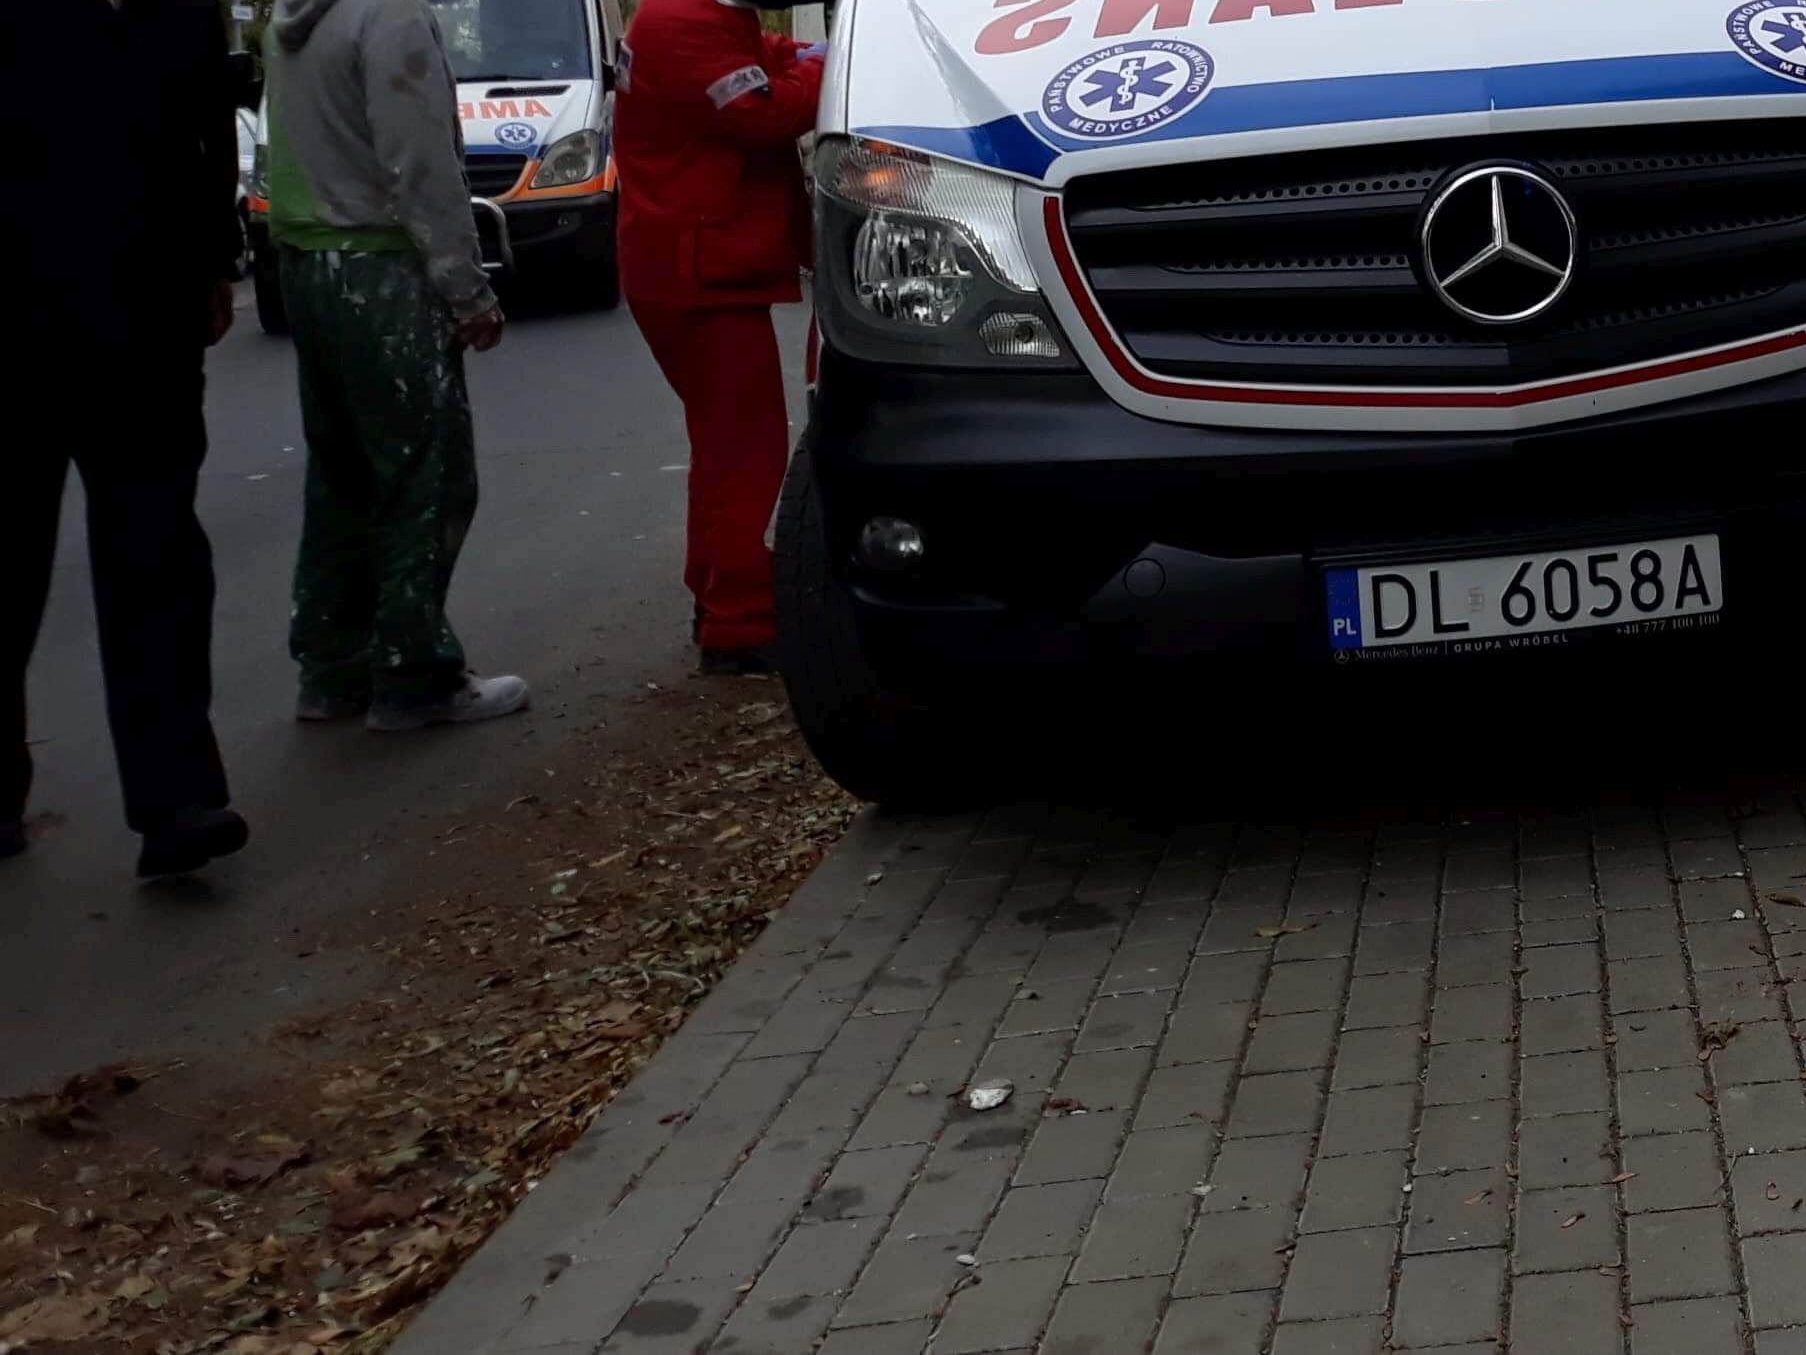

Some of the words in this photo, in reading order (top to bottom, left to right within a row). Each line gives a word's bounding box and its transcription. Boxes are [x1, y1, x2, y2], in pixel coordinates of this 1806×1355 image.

[1068, 104, 1174, 134] MEDYCZNE
[1370, 568, 1471, 639] DL
[1500, 543, 1713, 628] 6058A
[1332, 617, 1358, 637] PL
[1453, 640, 1503, 654] GRUPA
[1509, 633, 1569, 649] WRÓBEL
